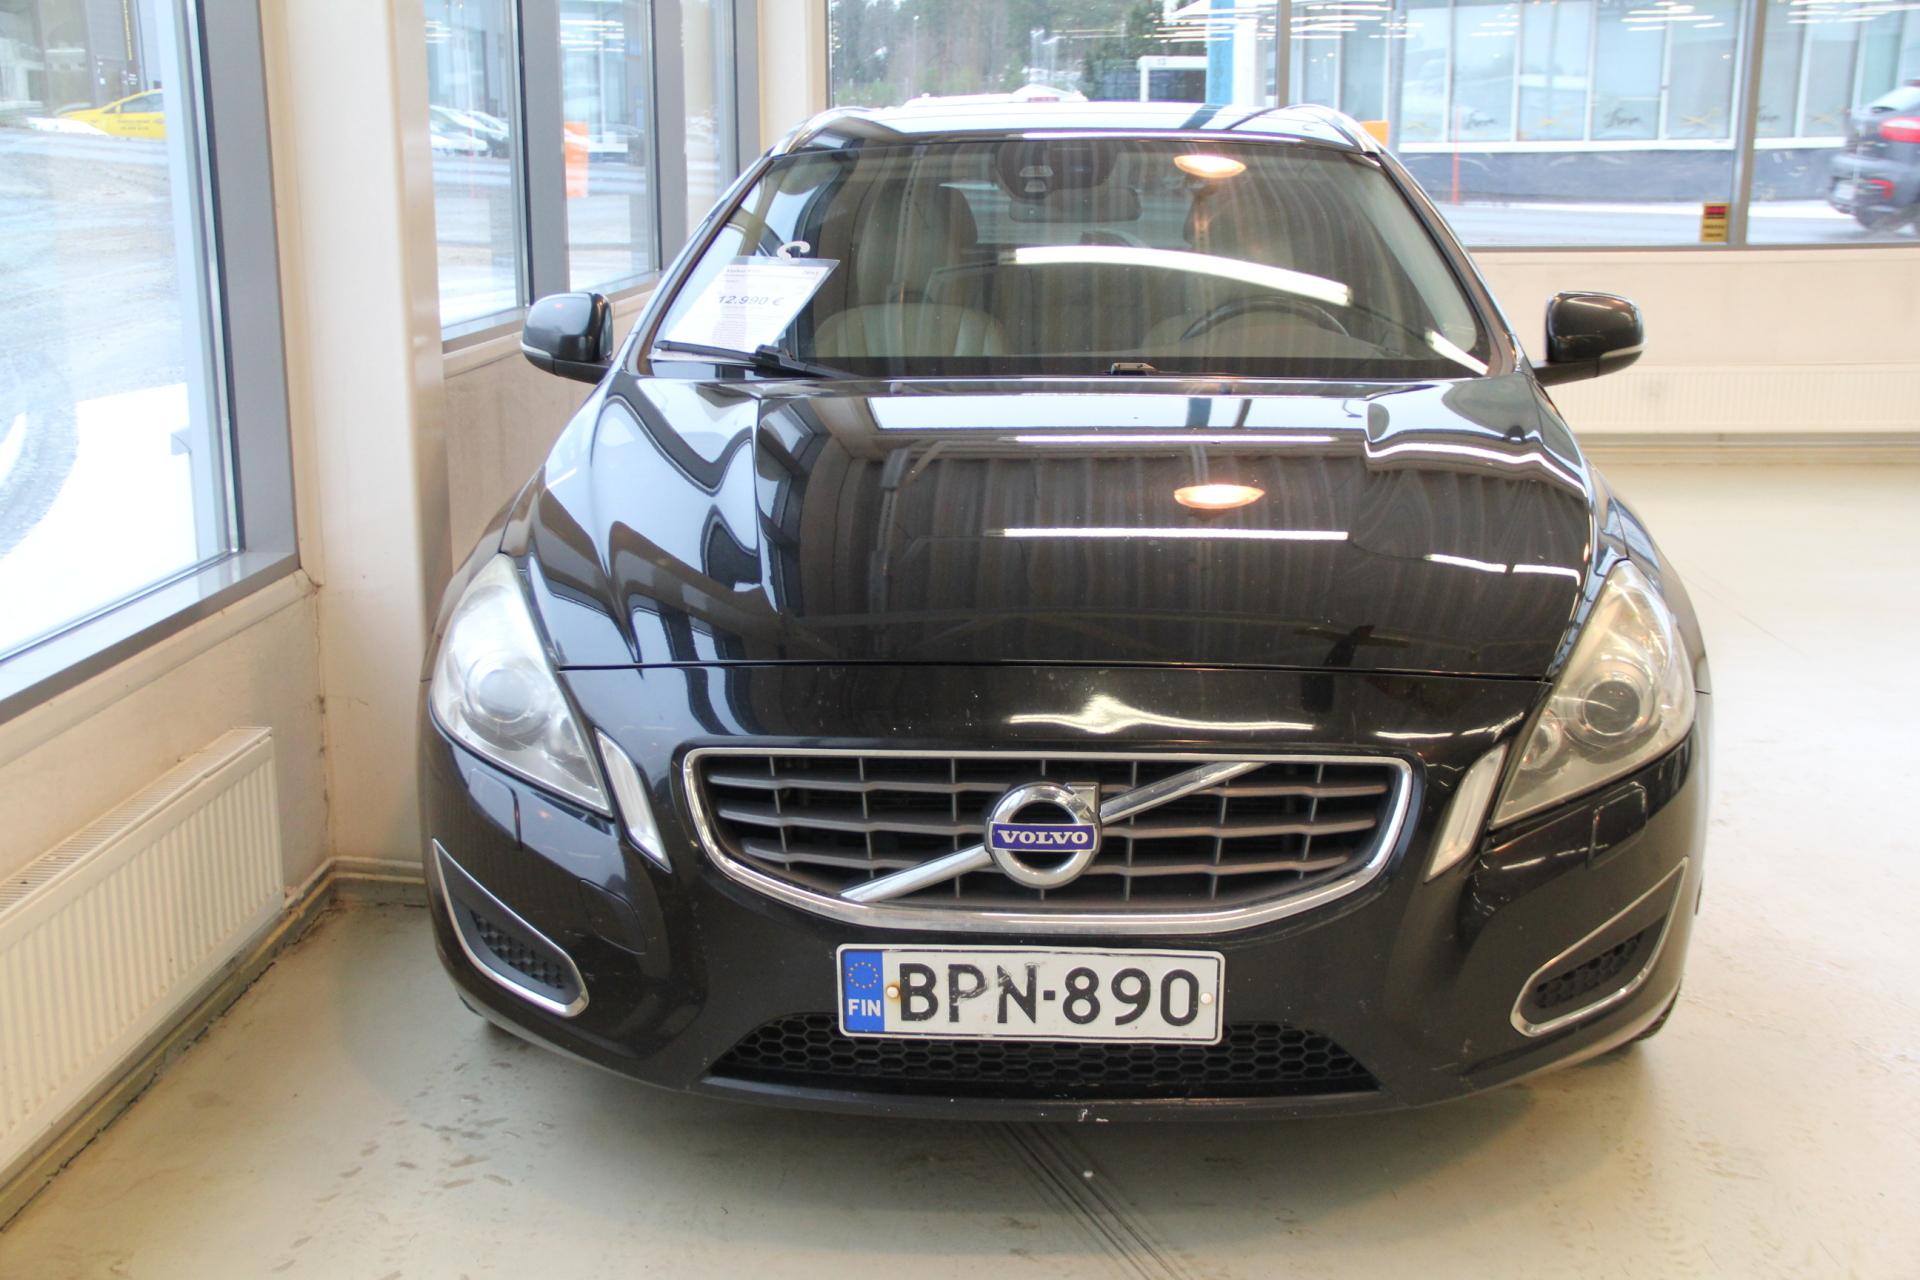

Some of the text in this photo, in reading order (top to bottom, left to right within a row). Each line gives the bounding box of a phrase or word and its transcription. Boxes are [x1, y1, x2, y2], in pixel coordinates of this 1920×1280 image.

[998, 830, 1088, 844] VOLVO
[899, 962, 1200, 1027] BPN-890
[848, 998, 881, 1016] FIN
